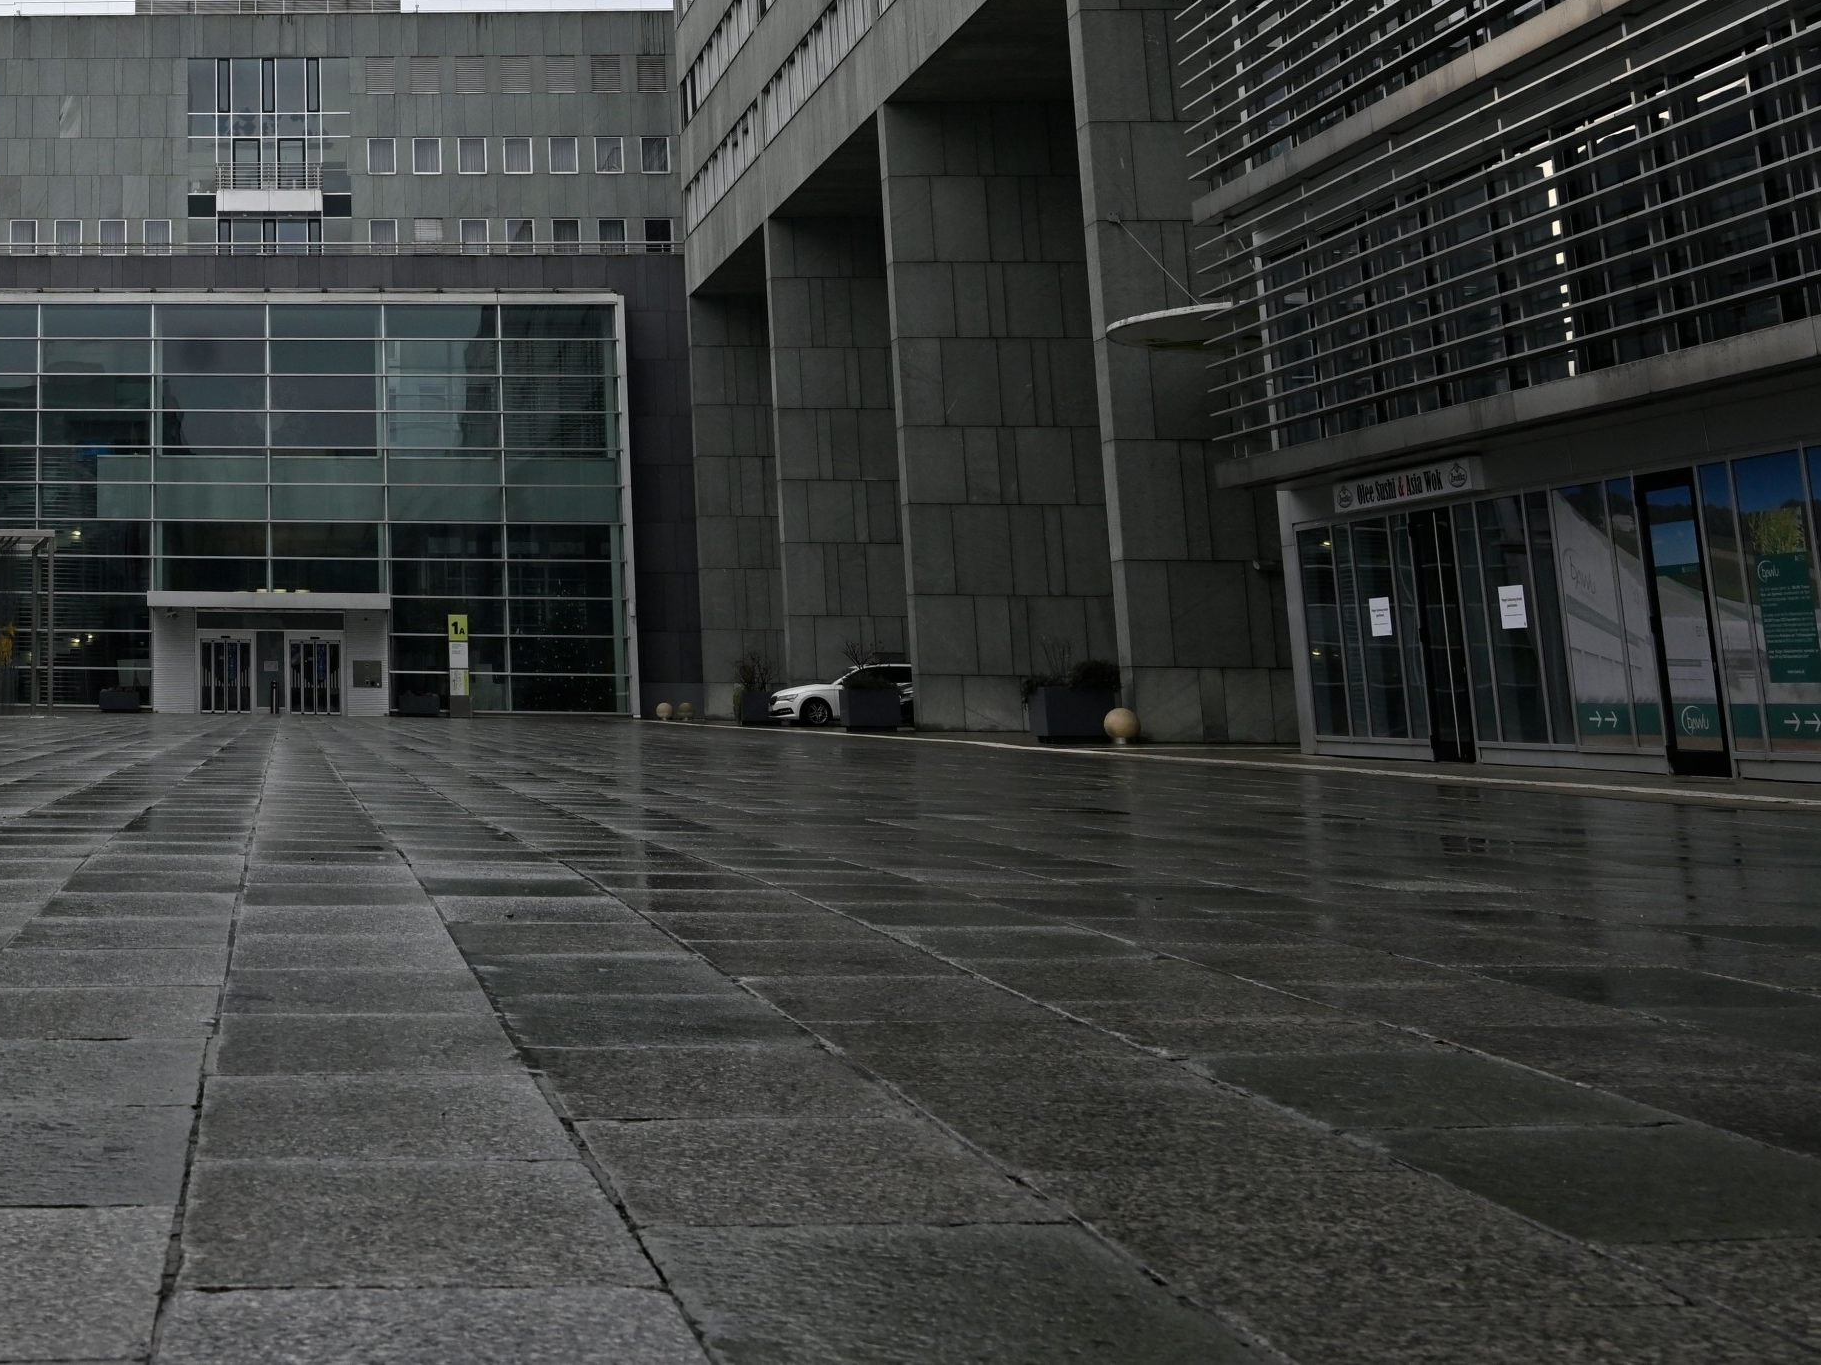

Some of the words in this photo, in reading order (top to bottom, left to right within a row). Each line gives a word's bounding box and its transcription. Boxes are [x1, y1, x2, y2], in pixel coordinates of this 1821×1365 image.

[1356, 483, 1375, 505] Olee
[1375, 477, 1397, 502] Sushi
[1397, 476, 1405, 497] &
[1405, 473, 1423, 496] Asia
[1423, 469, 1444, 492] Wok
[451, 621, 466, 635] 1A
